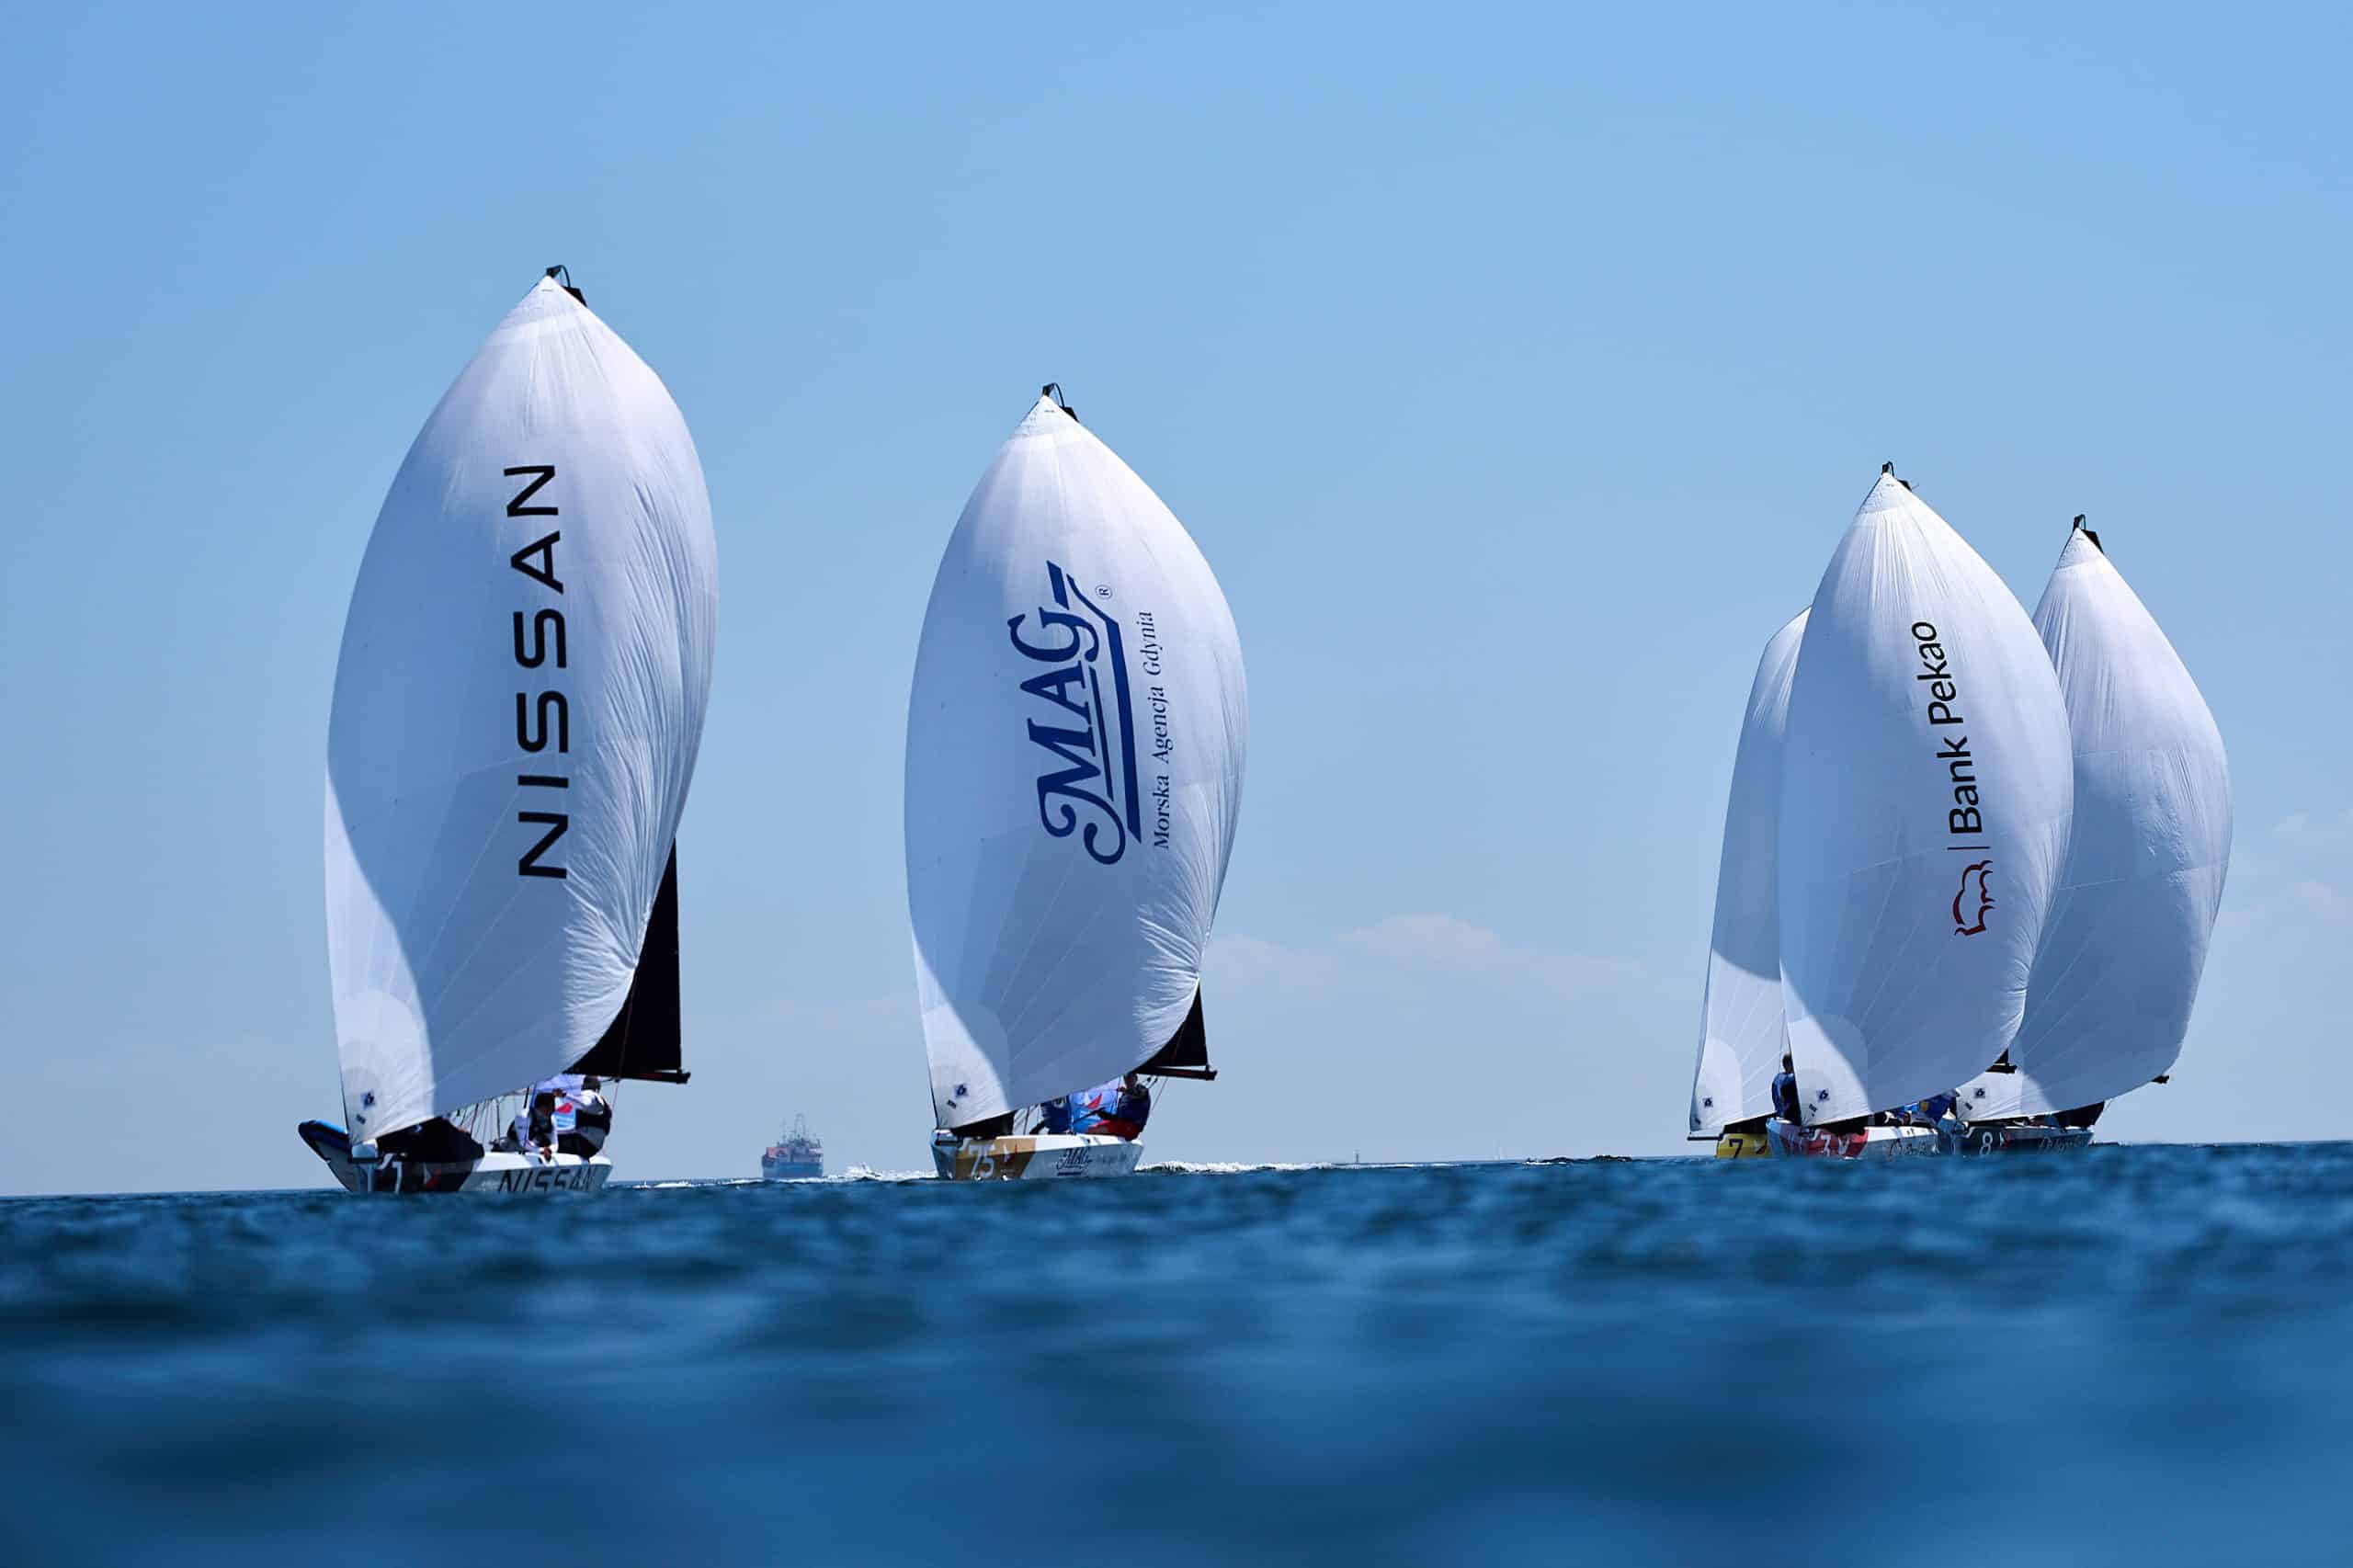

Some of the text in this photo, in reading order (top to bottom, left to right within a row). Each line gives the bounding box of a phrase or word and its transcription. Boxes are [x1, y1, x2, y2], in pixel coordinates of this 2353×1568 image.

[503, 464, 569, 880] NISSAN
[1007, 606, 1126, 865] MAG
[1136, 611, 1174, 850] Morska Agencja Gdynia
[1911, 621, 1983, 835] Bank Pekao
[969, 1143, 995, 1178] 75
[1729, 1138, 1744, 1158] 7
